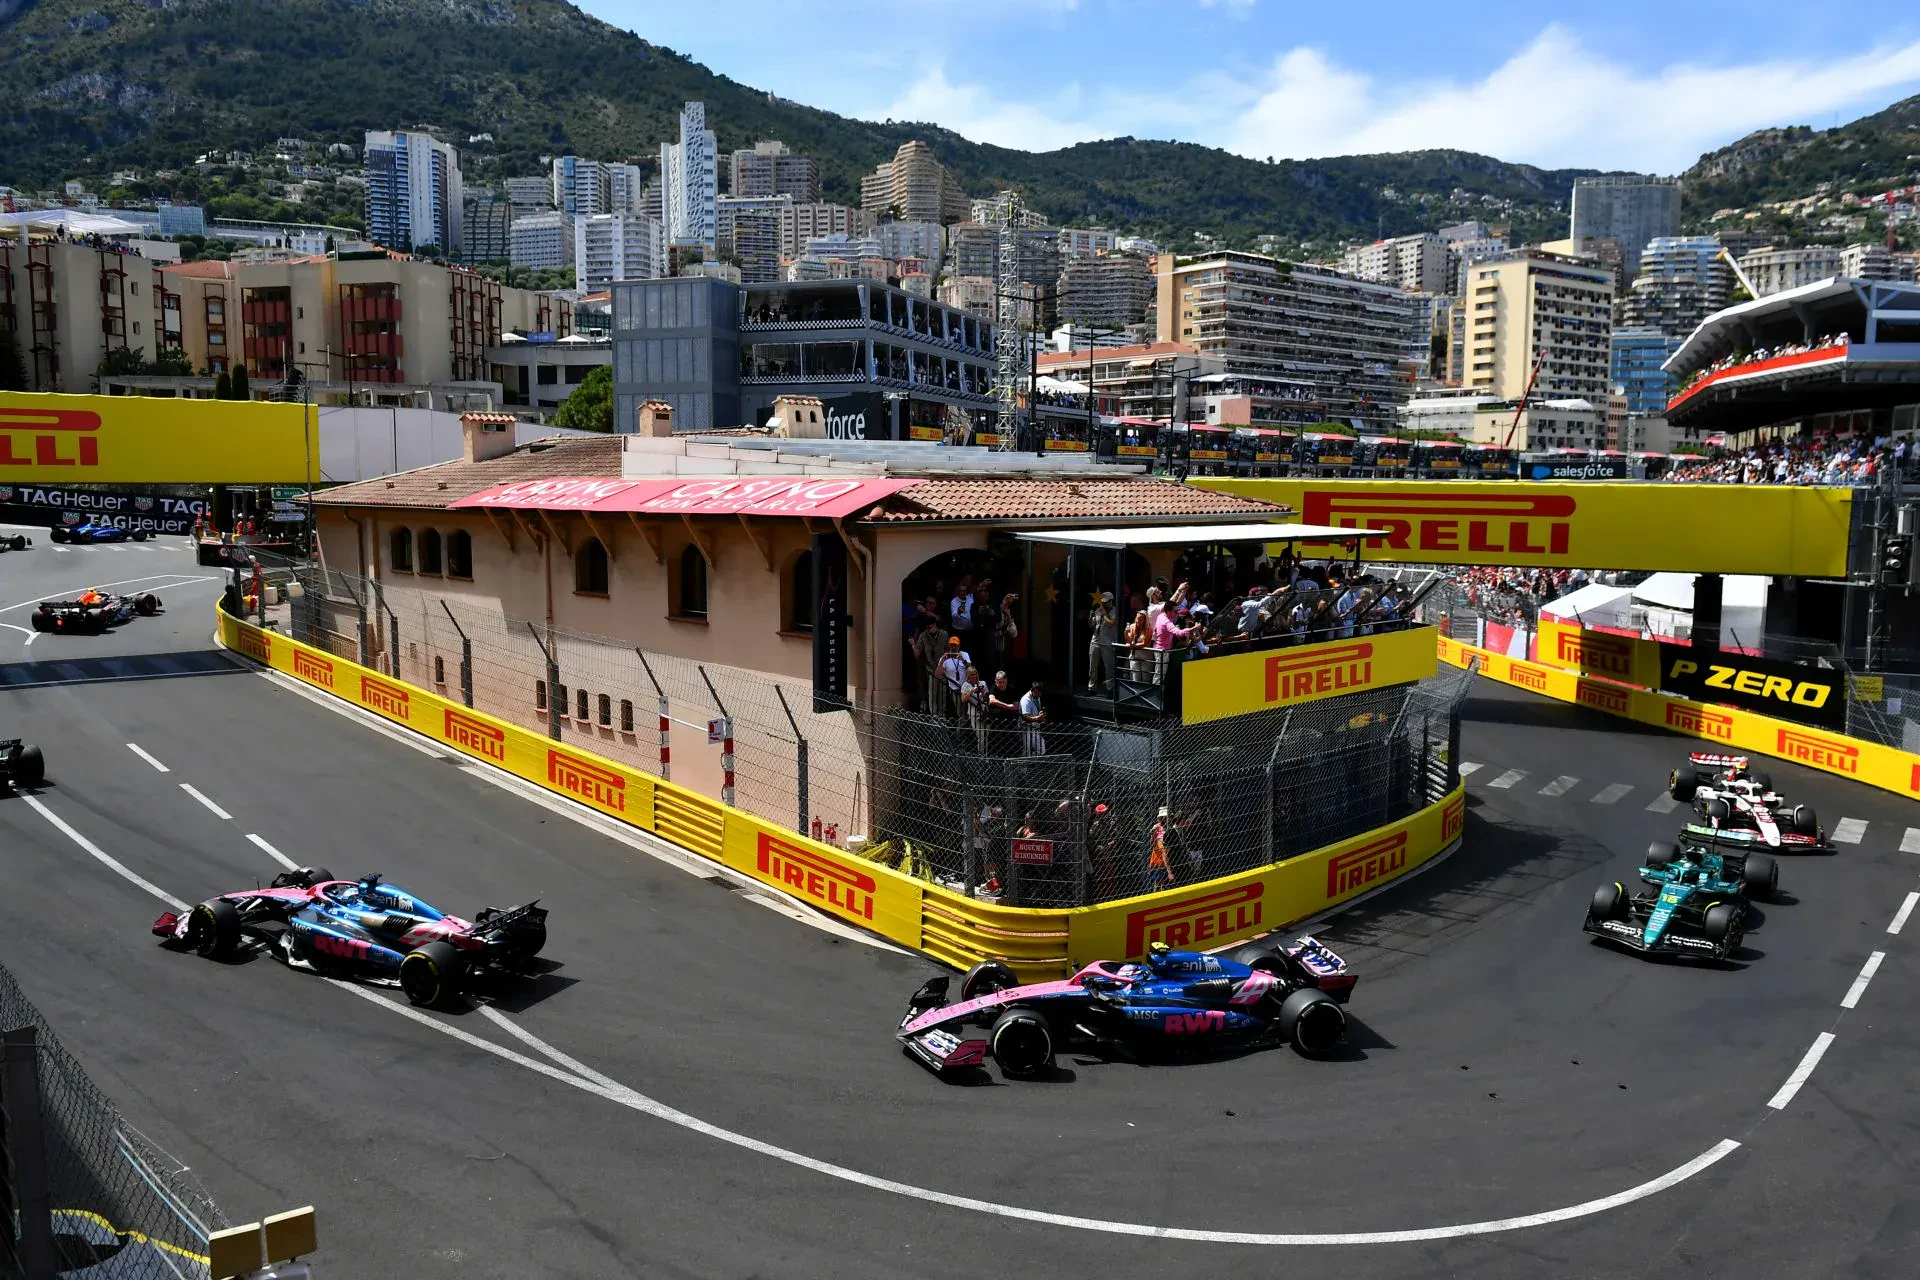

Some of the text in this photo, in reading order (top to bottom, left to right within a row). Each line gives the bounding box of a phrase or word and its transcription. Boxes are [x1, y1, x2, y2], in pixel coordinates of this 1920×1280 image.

[671, 481, 860, 499] CASINO
[1553, 465, 1614, 479] salesforce
[294, 648, 334, 688] PIRELLI
[1265, 643, 1373, 702] PIRELLI
[1510, 662, 1547, 690] PIRELLI
[1558, 632, 1630, 676] PIRELLI
[361, 675, 409, 720] PIRELLI
[1576, 681, 1628, 712] PIRELLI
[1670, 659, 1698, 678] P
[1704, 665, 1831, 708] ZERO
[444, 708, 504, 761] PIRELLI
[1666, 702, 1733, 740] PIRELLI
[1777, 728, 1859, 774] PIRELLI
[548, 749, 625, 812] PIRELLI
[757, 831, 876, 920] PIRELLI
[1327, 831, 1407, 899] PIRELLI
[1125, 882, 1264, 959] PIRELLI
[1182, 958, 1201, 971] eni
[1134, 1011, 1160, 1020] MSC
